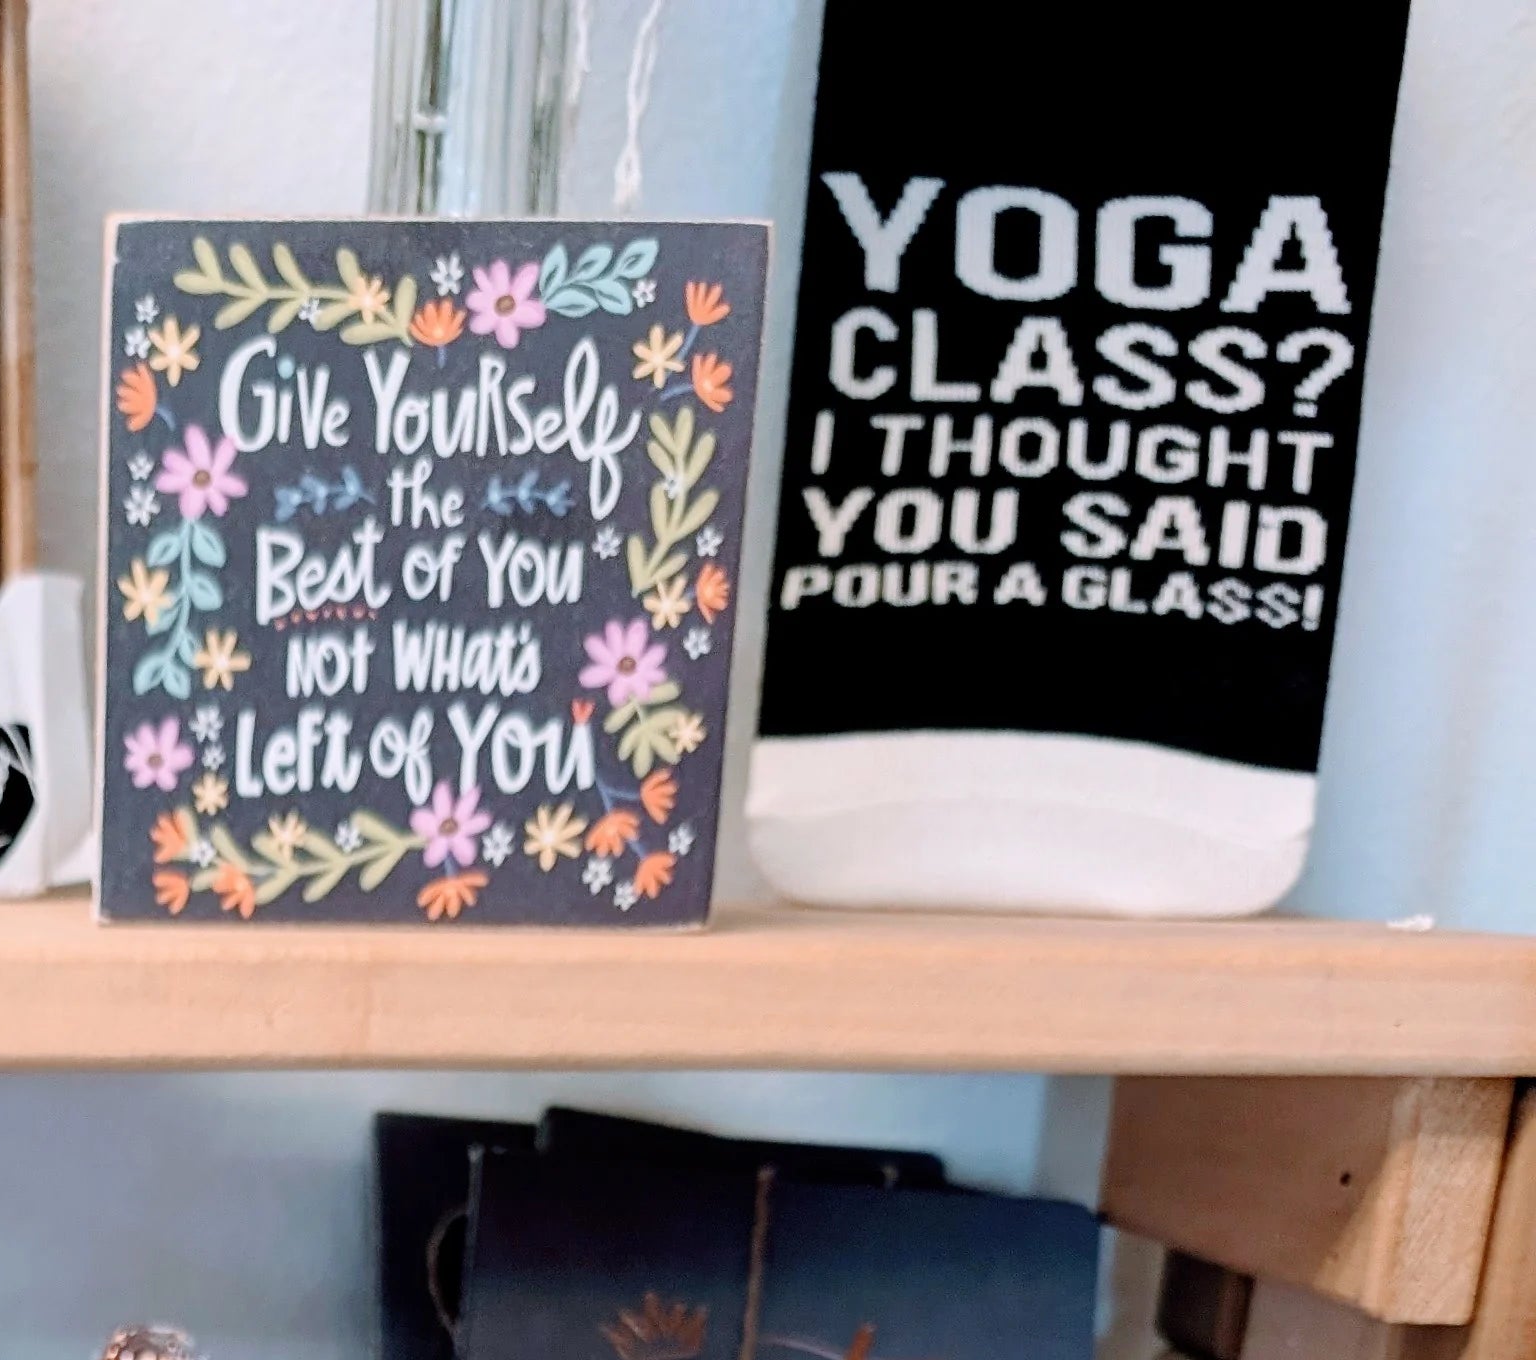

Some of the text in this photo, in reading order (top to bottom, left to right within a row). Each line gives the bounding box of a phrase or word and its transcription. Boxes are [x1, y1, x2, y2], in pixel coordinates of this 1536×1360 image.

[820, 171, 1352, 314] YOGA
[828, 306, 1355, 417] CLASS?
[387, 456, 465, 530] the
[810, 409, 1334, 496] I THOUGHT
[256, 516, 392, 627] Best
[402, 532, 466, 602] of
[802, 487, 1328, 576] YOU SAID
[780, 561, 1325, 631] POUR A GLASS!
[369, 706, 435, 806] of
